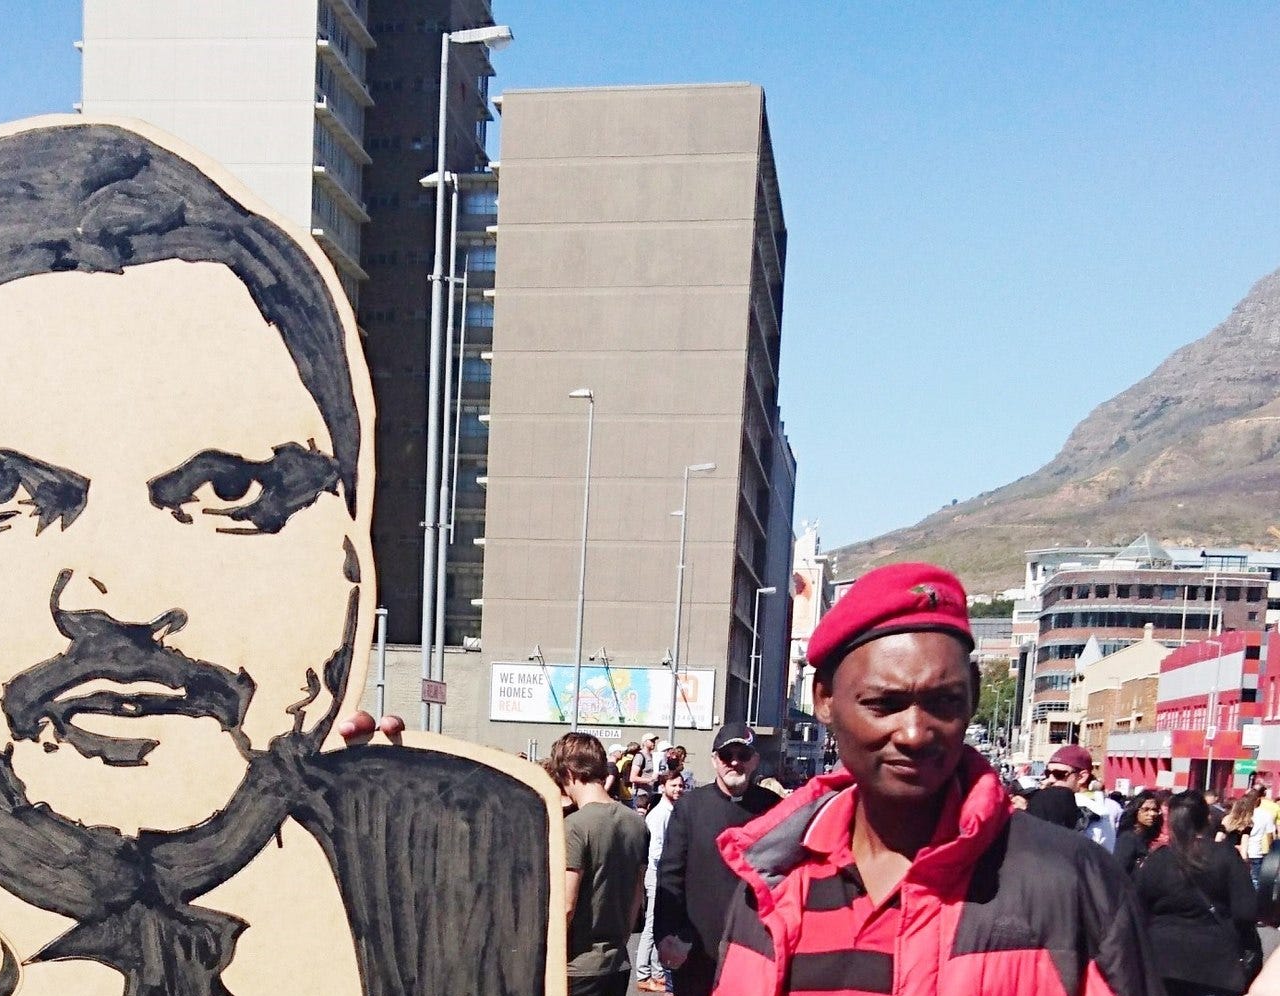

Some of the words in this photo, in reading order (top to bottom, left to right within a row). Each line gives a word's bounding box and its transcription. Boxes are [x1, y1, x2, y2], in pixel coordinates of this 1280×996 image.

[499, 672, 514, 684] WE
[518, 673, 544, 685] MAKE
[499, 686, 533, 699] HOMES
[498, 700, 522, 713] REAL
